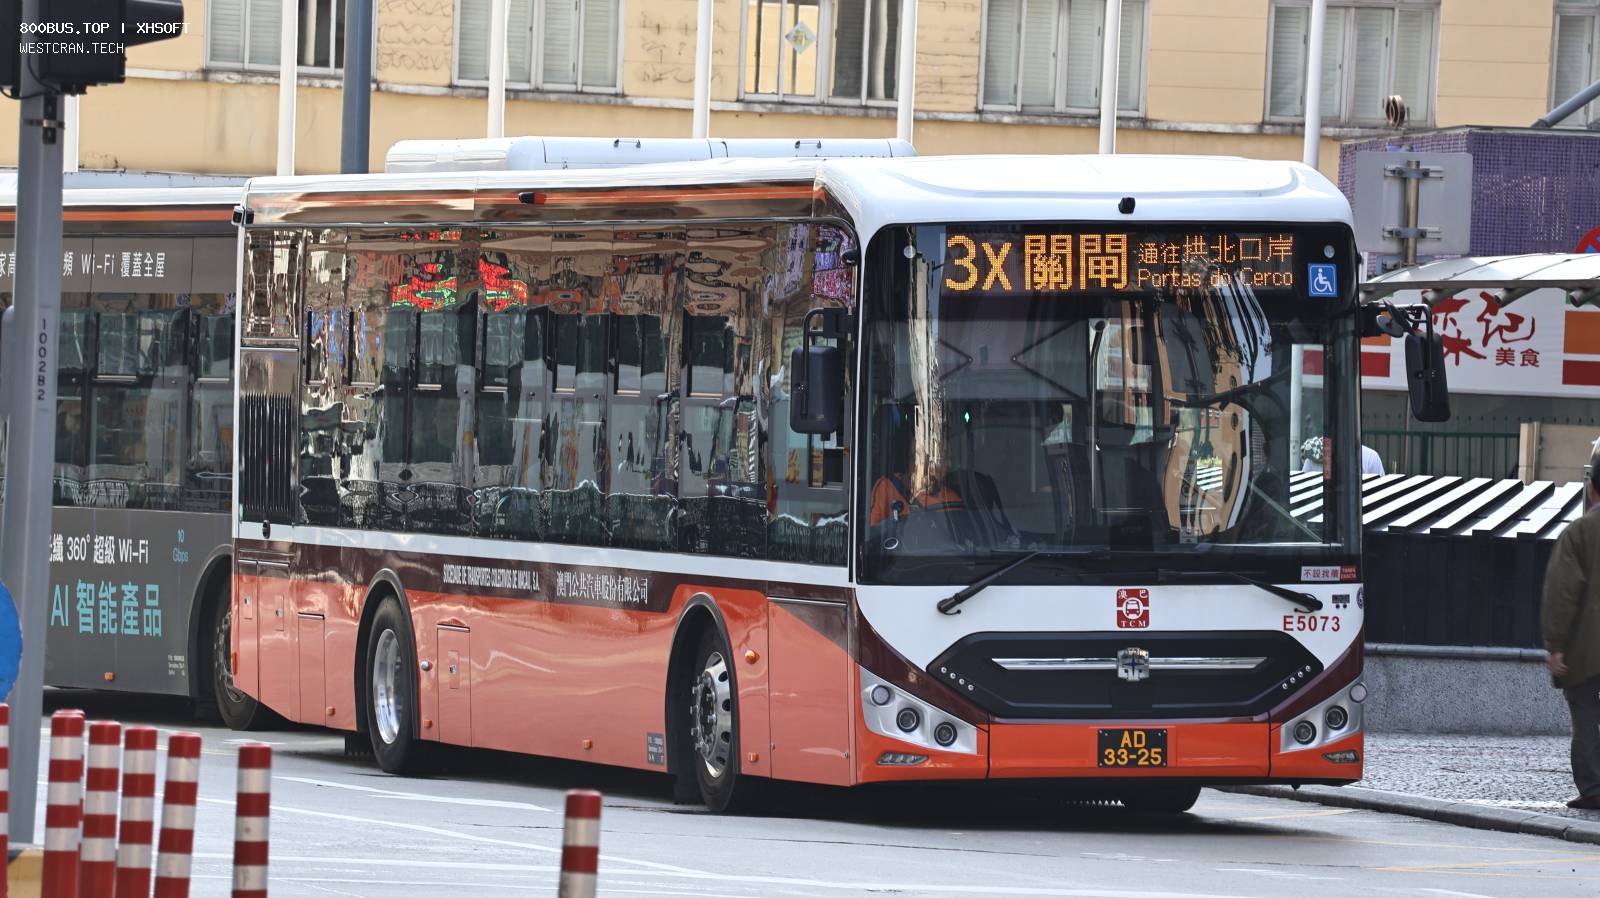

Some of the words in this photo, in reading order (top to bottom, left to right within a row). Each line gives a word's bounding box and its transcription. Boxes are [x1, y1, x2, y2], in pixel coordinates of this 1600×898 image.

[1138, 235, 1293, 264] 通往拱北口岸
[81, 253, 115, 275] Wi-Fi
[120, 251, 166, 278] 覆蓋全屋
[946, 235, 1012, 291] 3X
[1024, 234, 1127, 290] 關閘
[1138, 267, 1201, 288] Portas
[1211, 267, 1232, 288] do
[1241, 267, 1293, 287] Cerco
[1495, 347, 1540, 368] 美食
[177, 528, 185, 543] 10
[93, 534, 116, 564] 超級
[118, 538, 149, 565] Wi-Fi
[172, 547, 189, 564] Gbps
[50, 584, 69, 626] AI
[76, 579, 162, 637] 智能產品
[1282, 615, 1341, 632] E5073
[1120, 730, 1146, 748] AD
[1103, 748, 1162, 766] 33-25
